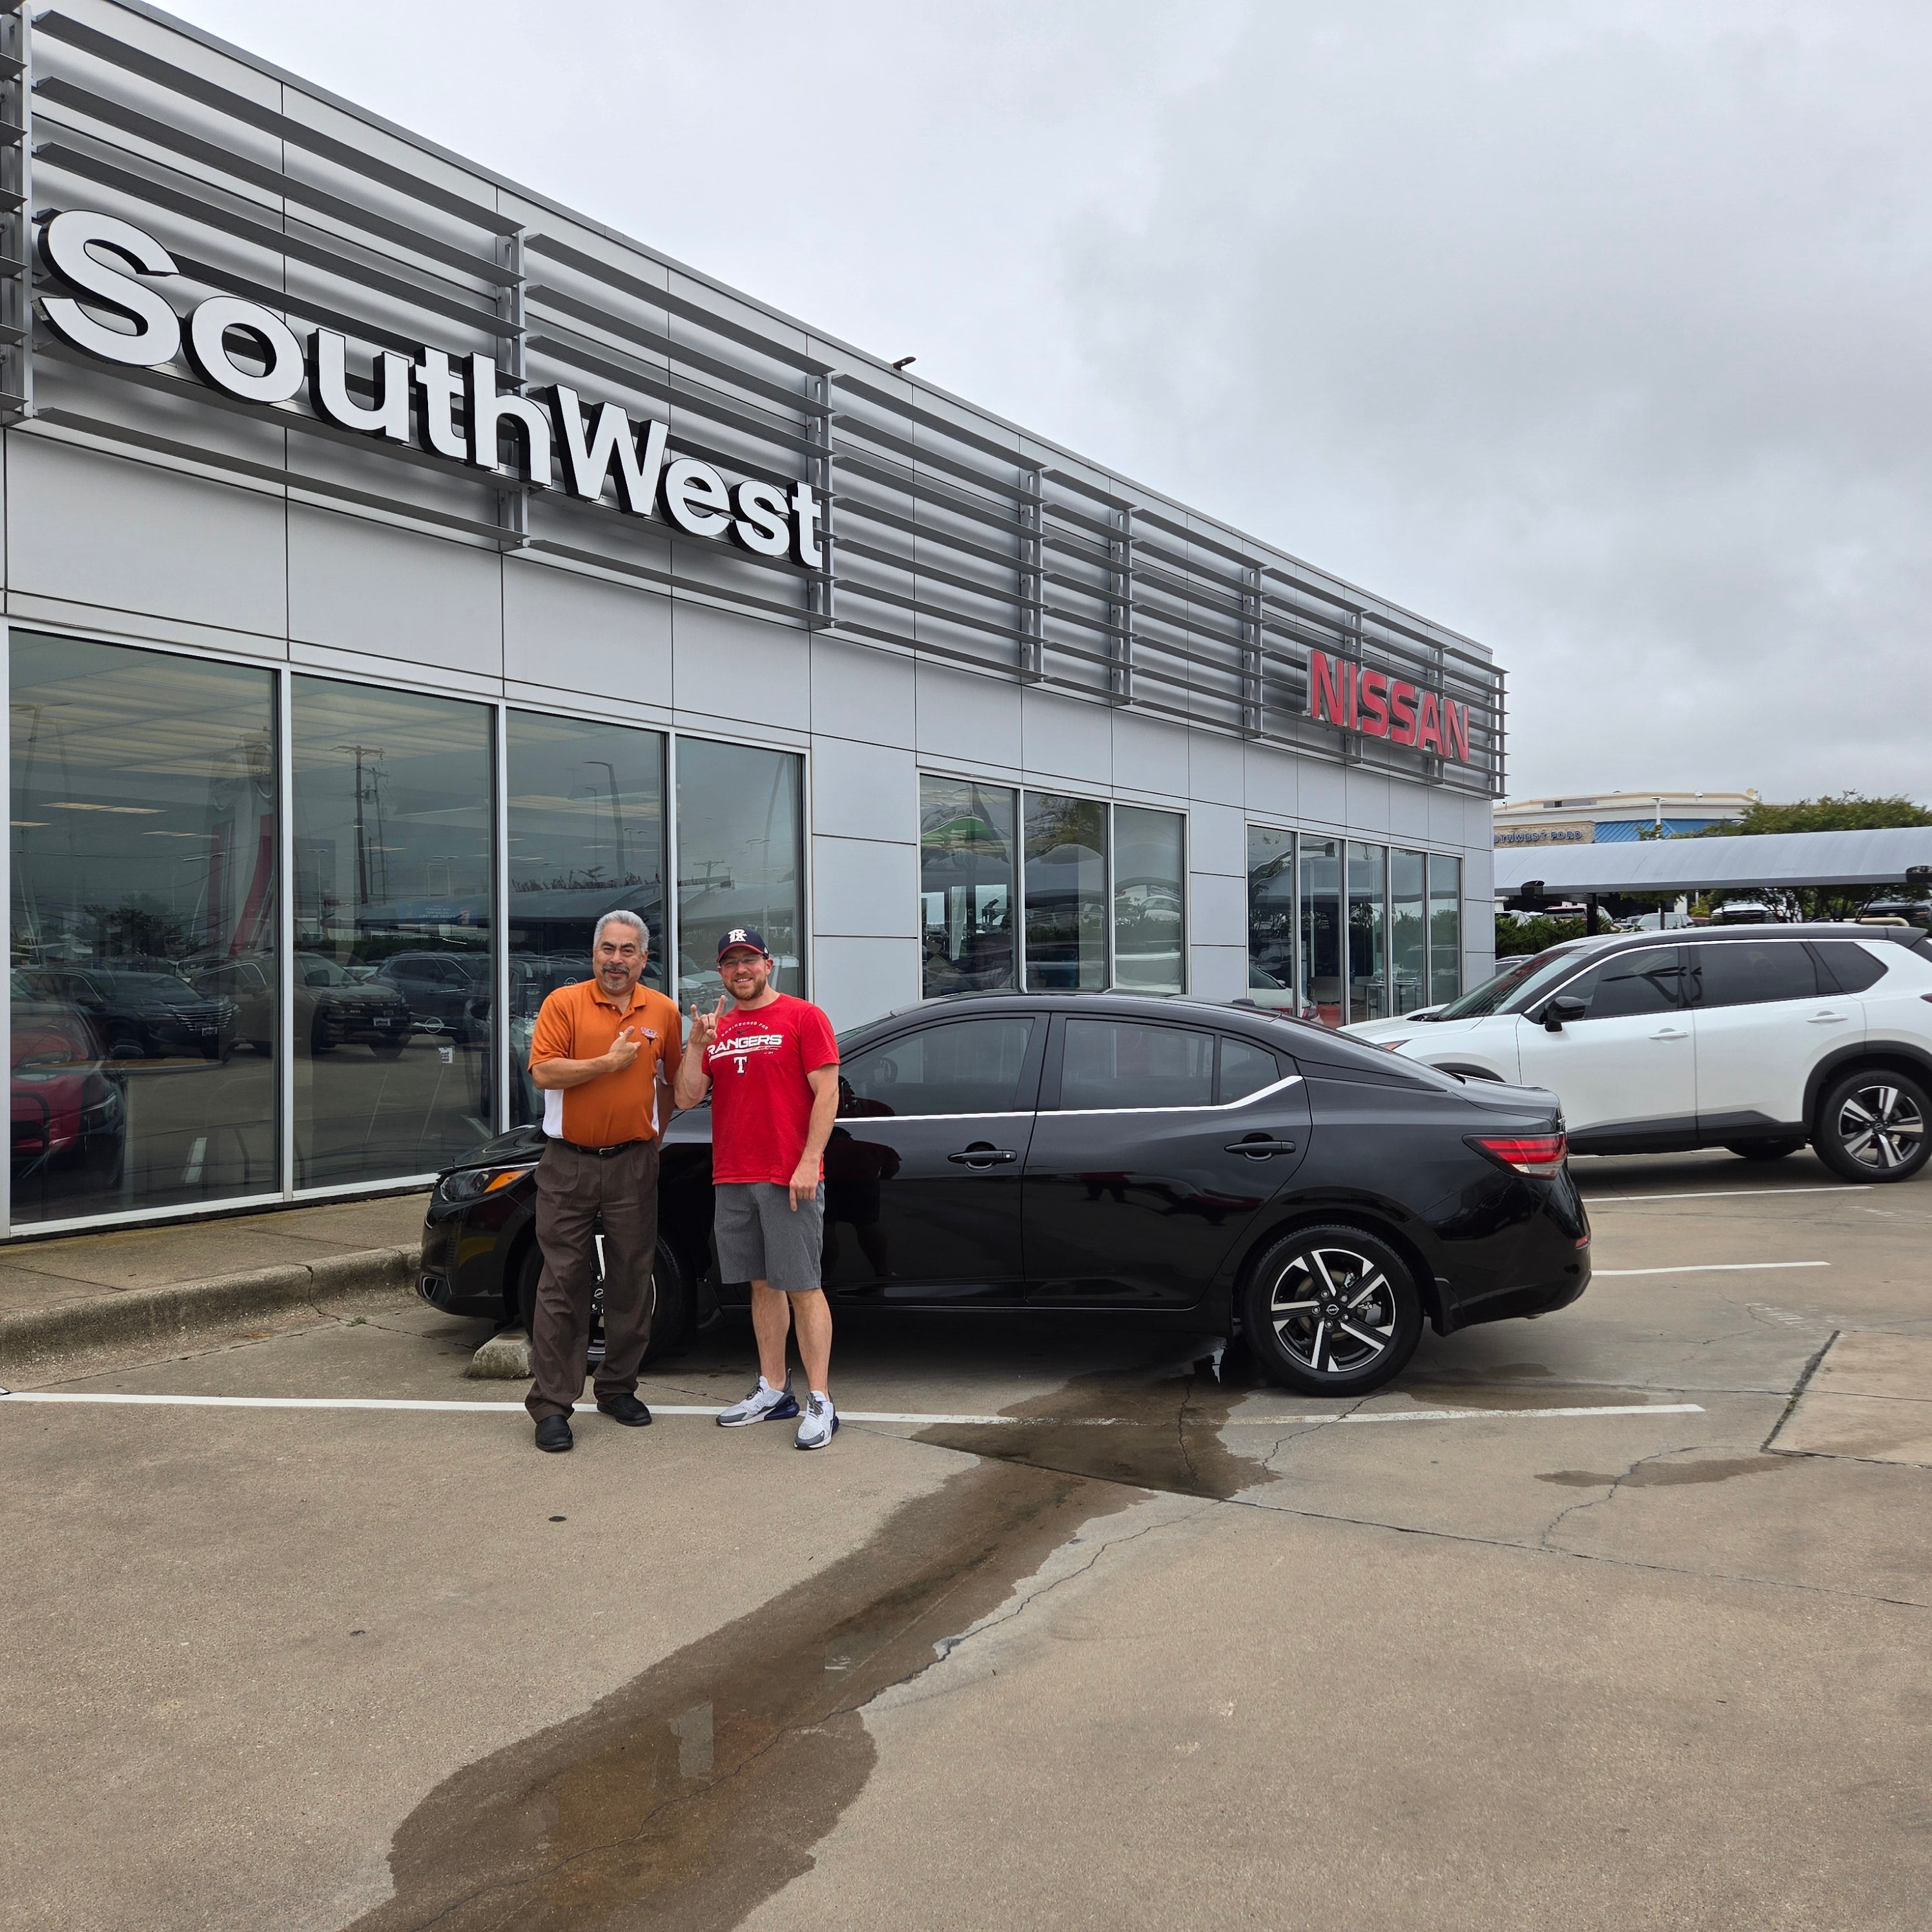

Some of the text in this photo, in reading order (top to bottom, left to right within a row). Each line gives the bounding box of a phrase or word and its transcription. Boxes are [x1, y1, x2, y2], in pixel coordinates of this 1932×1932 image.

[37, 209, 823, 570] SouthWest
[1308, 648, 1470, 763] NISSAN
[1550, 830, 1582, 840] FORD
[706, 1034, 783, 1057] RANGERS
[733, 1056, 748, 1074] T
